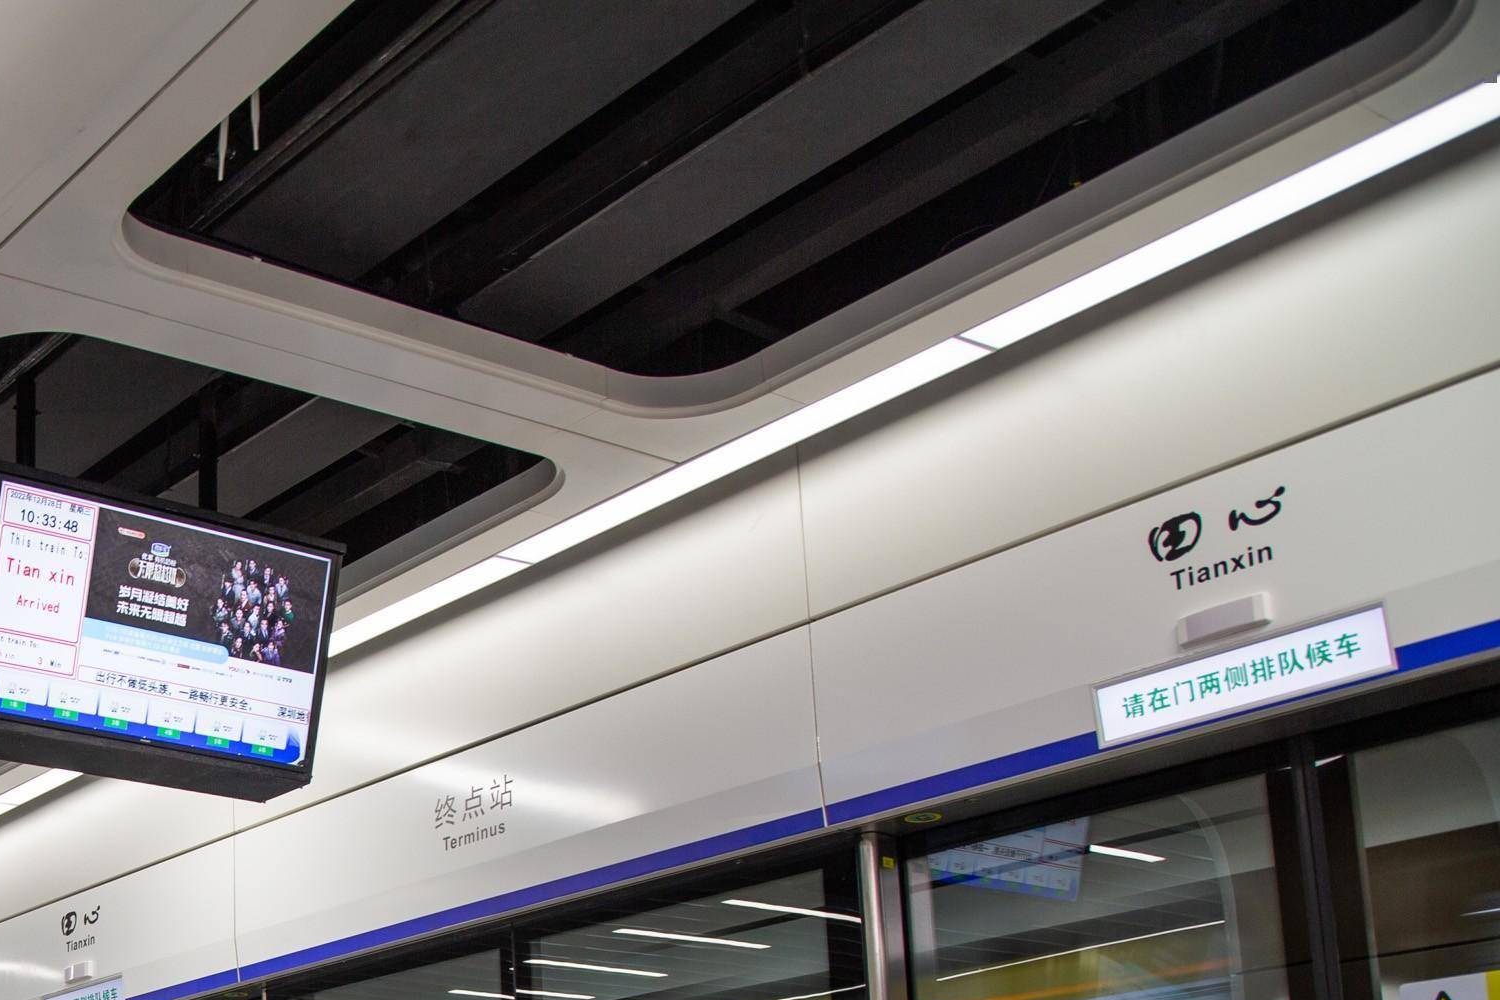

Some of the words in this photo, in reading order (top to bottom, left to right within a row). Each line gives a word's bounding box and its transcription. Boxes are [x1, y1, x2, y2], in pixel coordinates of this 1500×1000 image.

[21, 509, 78, 533] 10:33:48
[11, 532, 30, 548] This
[40, 541, 65, 555] train
[7, 557, 40, 578] Tian
[49, 569, 75, 586] xin
[1170, 542, 1273, 591] Tianxin
[16, 595, 60, 614] Arrived
[118, 585, 189, 612] 岁月凝结美好
[116, 601, 187, 627] 未来无限超越
[1122, 632, 1361, 719] 请在门两侧排队候车
[277, 706, 309, 722] 深圳地
[434, 774, 513, 829] 终点站
[442, 822, 506, 851] Terminus
[66, 934, 95, 952] Tianxin
